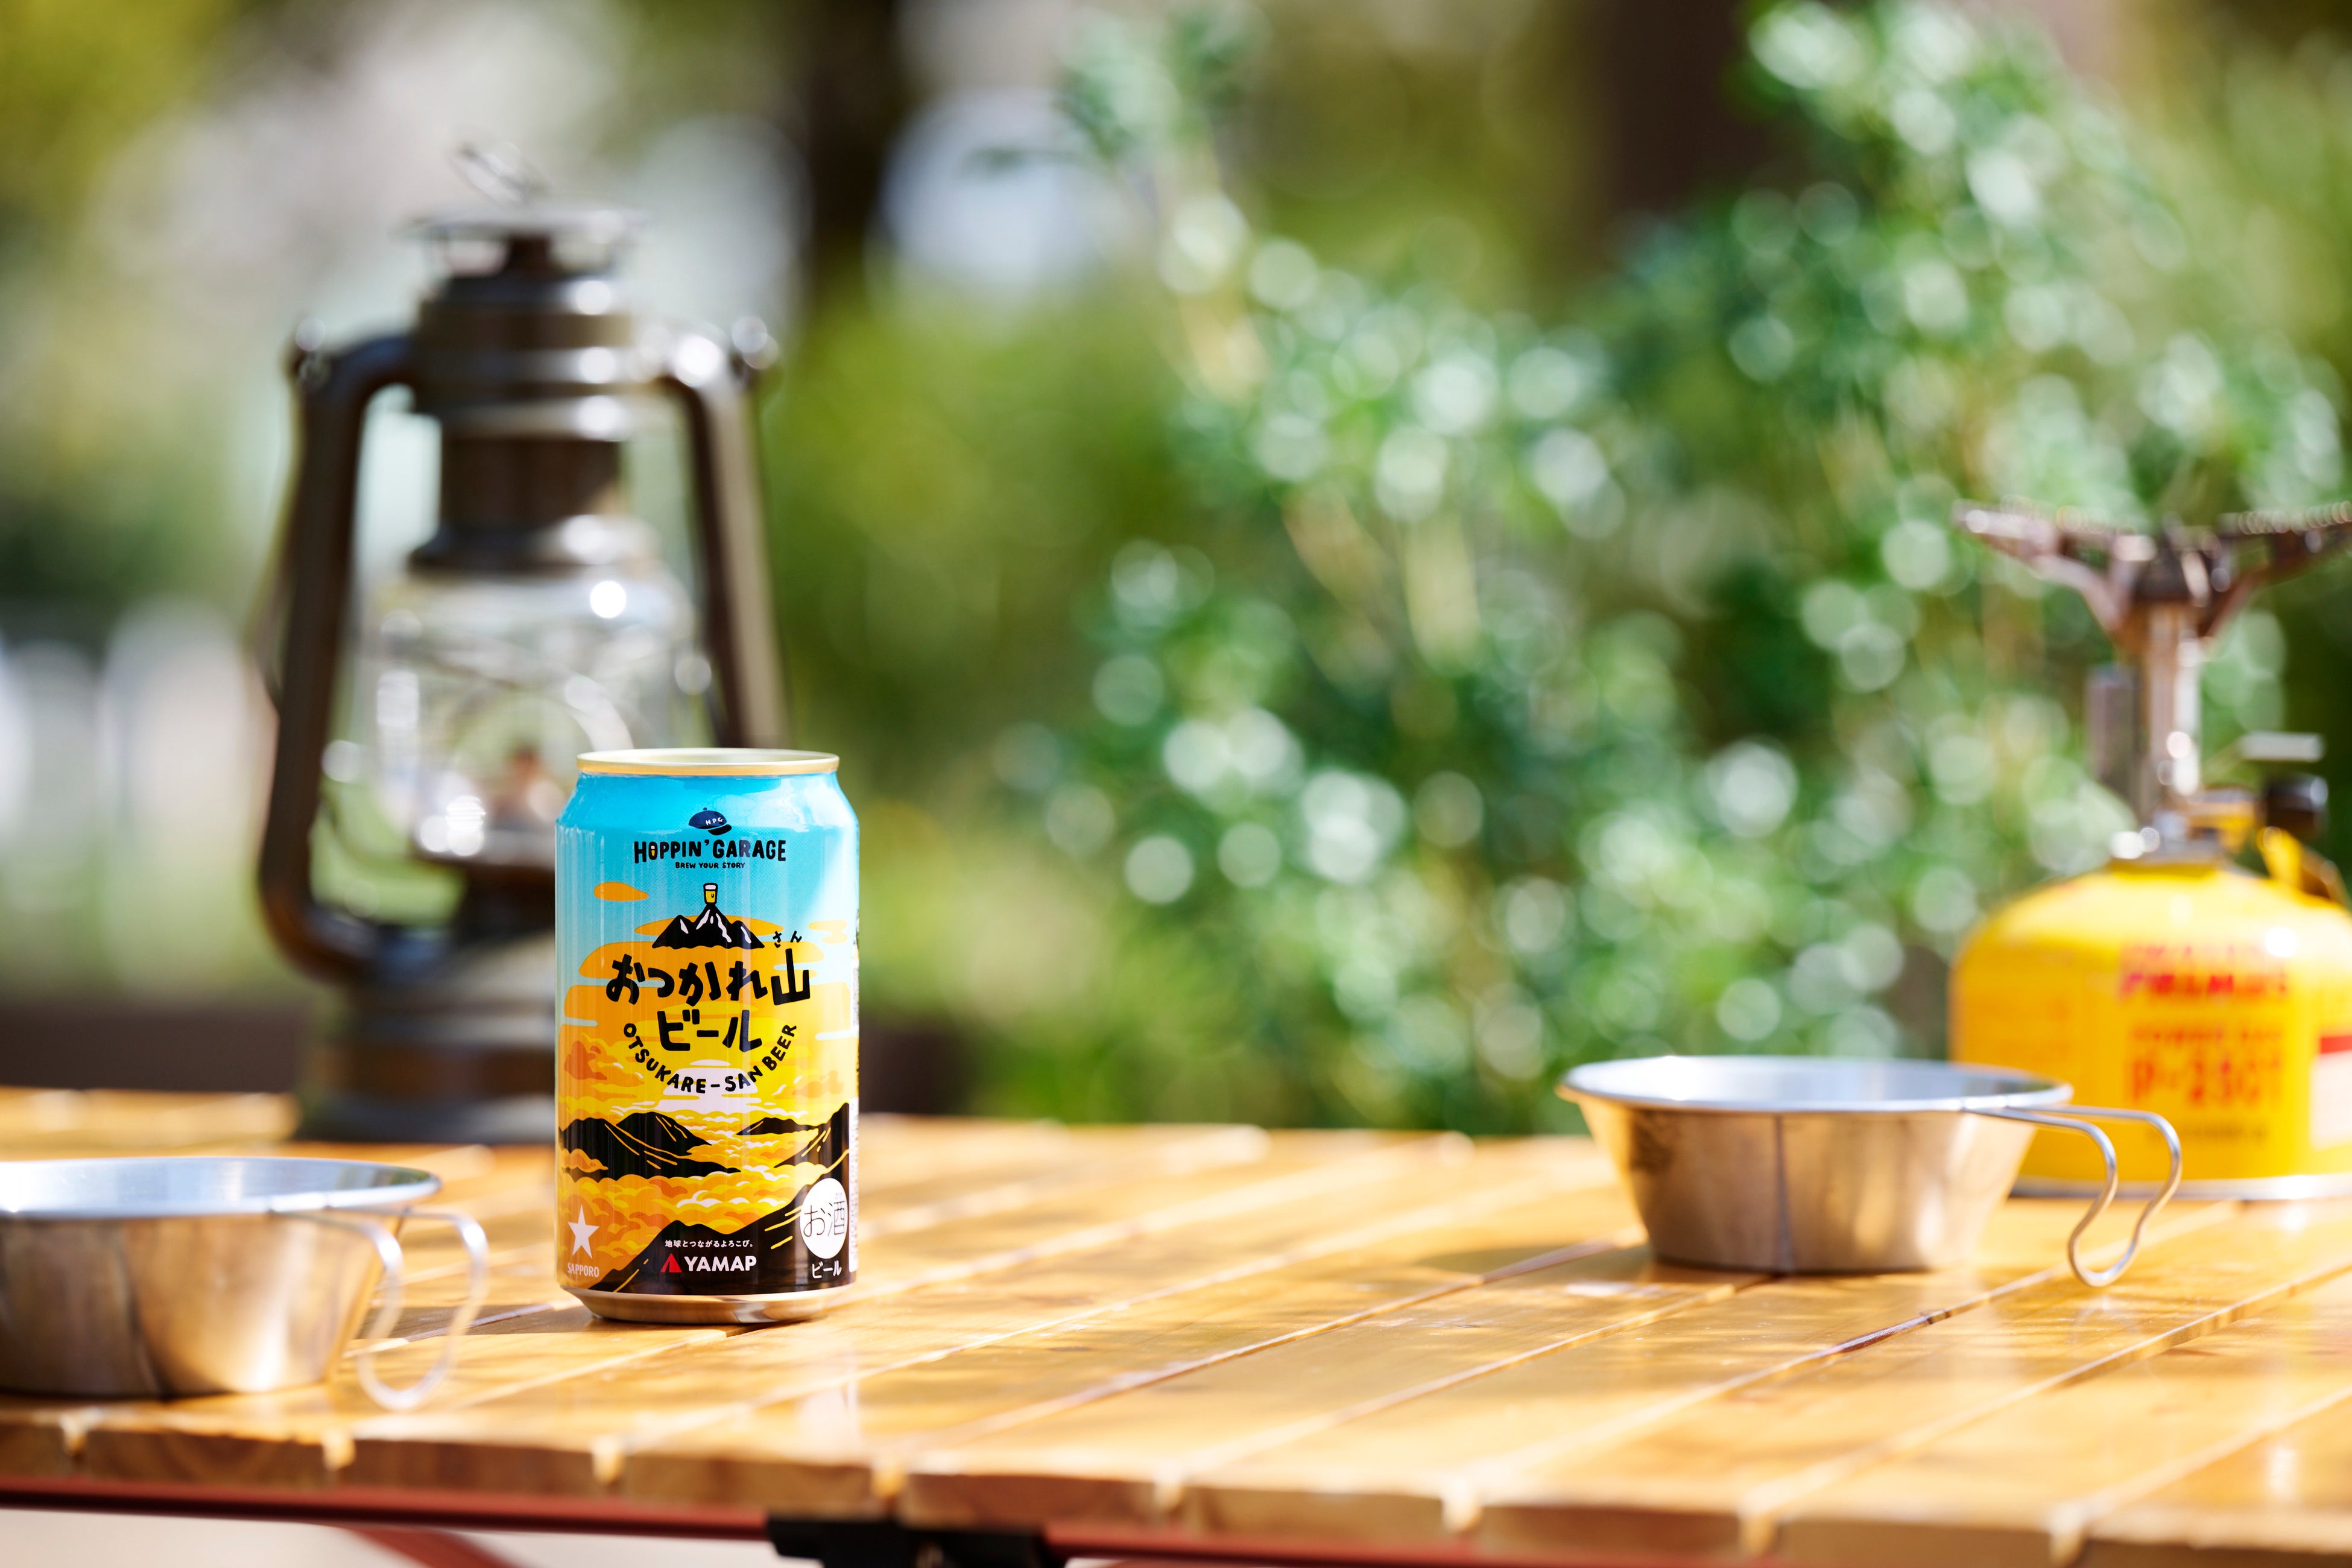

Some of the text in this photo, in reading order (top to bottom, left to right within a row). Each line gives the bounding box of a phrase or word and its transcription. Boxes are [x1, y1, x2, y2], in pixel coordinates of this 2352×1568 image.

[705, 817, 723, 826] HPG
[712, 839, 786, 861] GARAGE
[773, 931, 802, 948] さん
[606, 949, 811, 1007] おつかれ山
[657, 1009, 762, 1052] ビール
[762, 1025, 797, 1071] BEER
[803, 1201, 845, 1237] お酒
[665, 1239, 753, 1248] 地球とつながるよろこび。
[567, 1262, 599, 1278] SAPPORO
[684, 1256, 757, 1272] YAMAP
[812, 1260, 842, 1279] ビール
